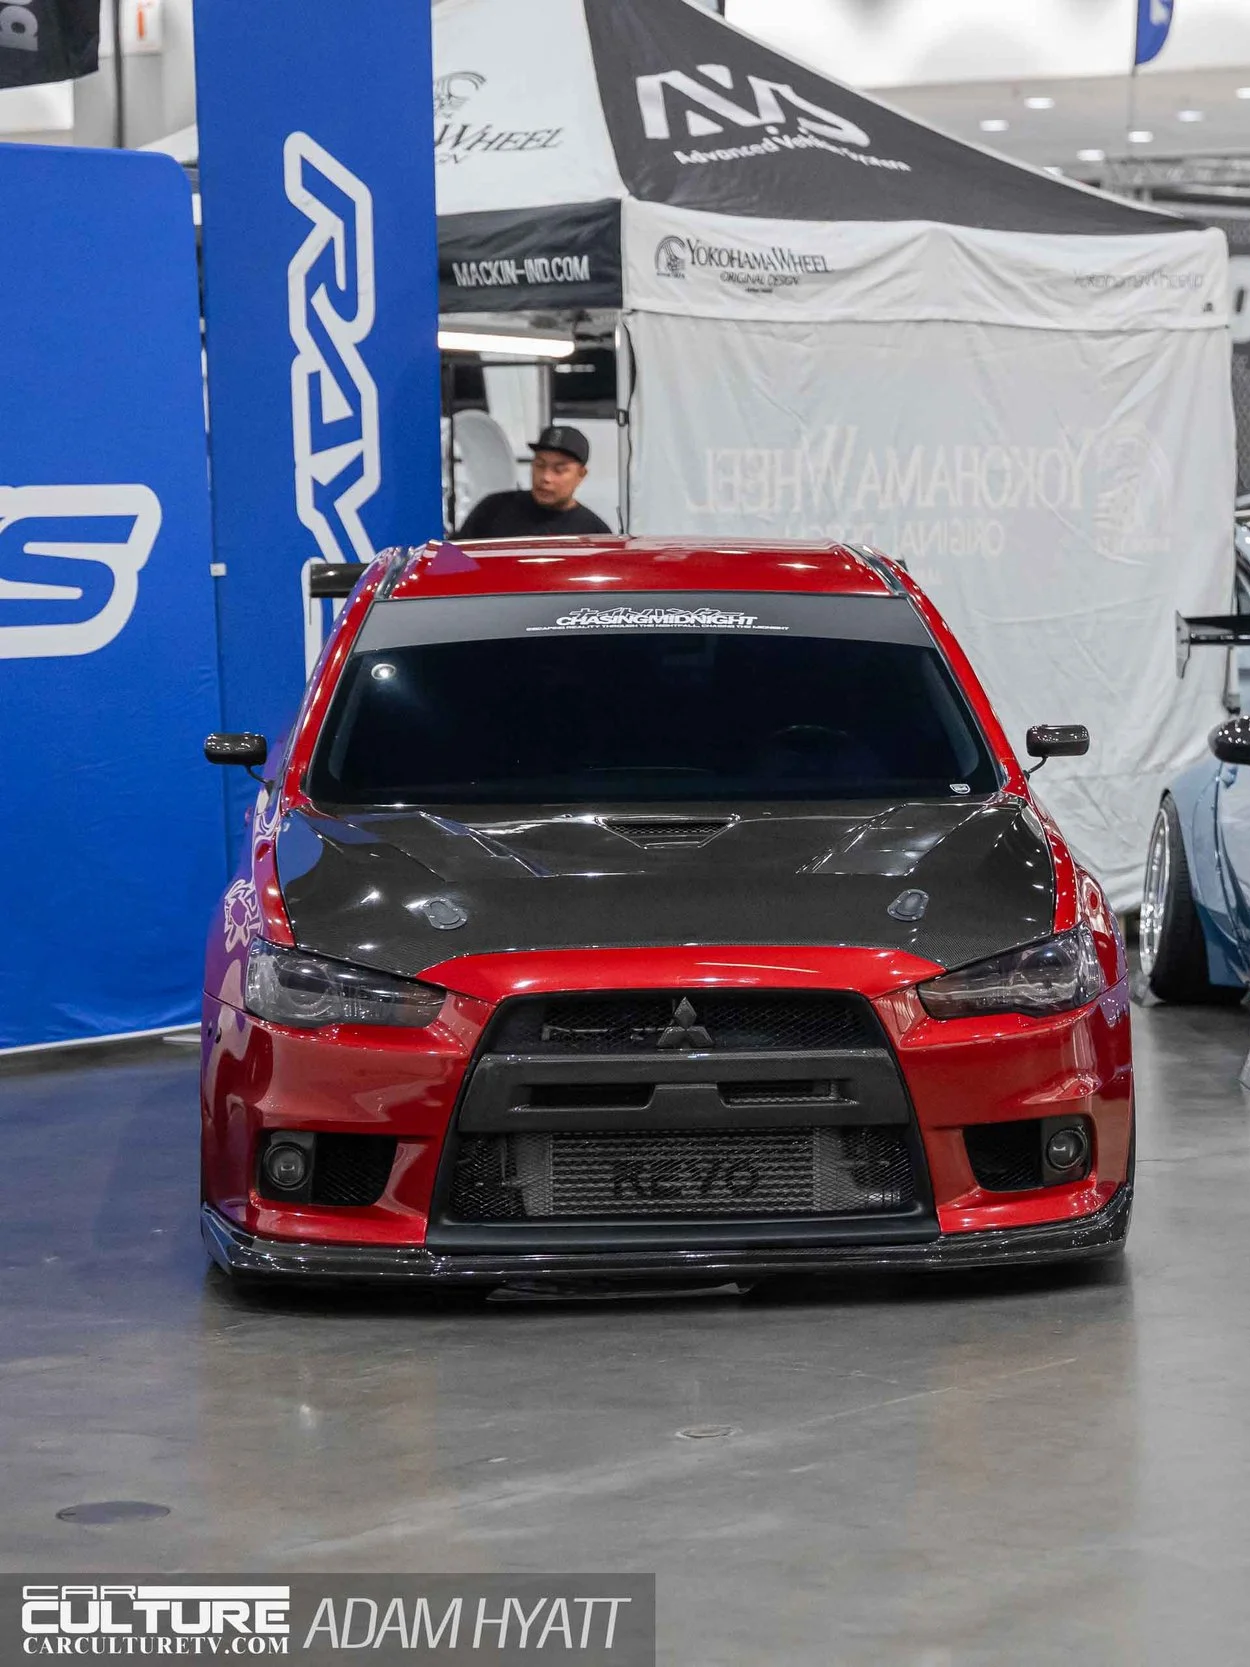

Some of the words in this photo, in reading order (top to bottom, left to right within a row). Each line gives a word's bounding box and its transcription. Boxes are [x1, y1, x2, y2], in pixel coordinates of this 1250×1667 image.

[452, 254, 590, 287] MACKIN-IND.COM
[720, 271, 765, 285] ORIGINAL
[283, 131, 381, 680] RAY
[556, 615, 758, 626] CHASINGMIDNIGHT
